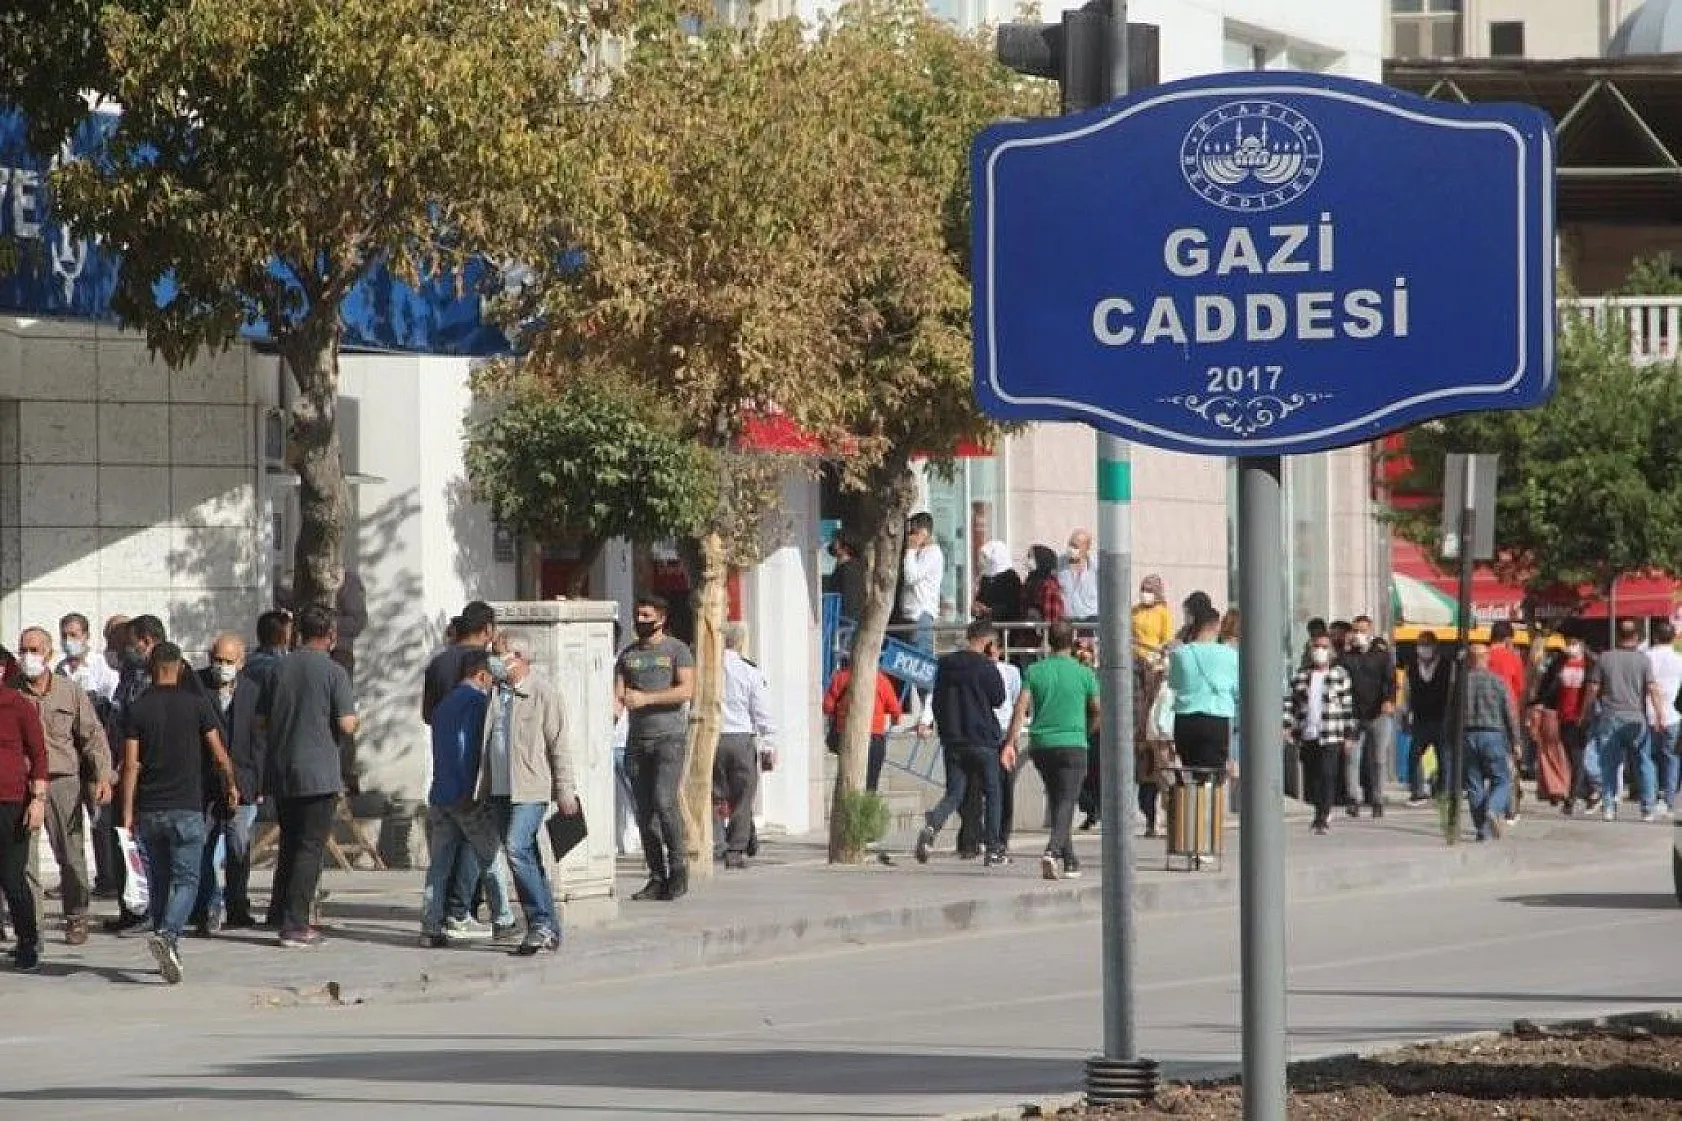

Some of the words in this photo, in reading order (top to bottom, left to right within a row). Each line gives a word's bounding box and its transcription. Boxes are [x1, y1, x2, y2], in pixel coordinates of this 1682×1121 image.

[1164, 212, 1335, 277] GAZİ
[1092, 277, 1409, 345] CADDESİ
[1207, 365, 1282, 392] 2017
